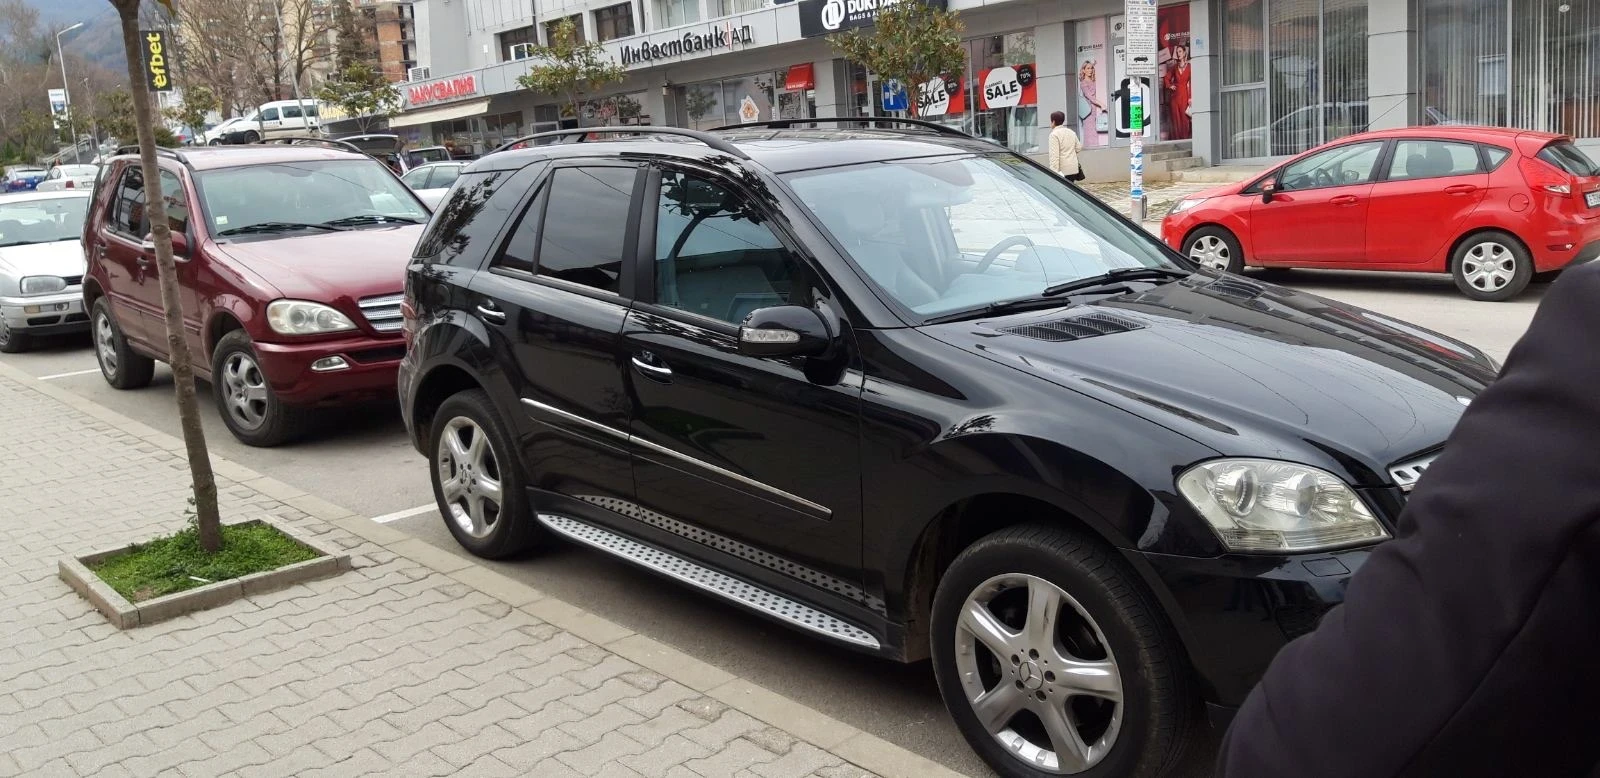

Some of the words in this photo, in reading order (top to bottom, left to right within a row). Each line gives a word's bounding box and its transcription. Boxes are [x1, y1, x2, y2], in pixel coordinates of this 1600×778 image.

[849, 12, 866, 21] BAGS
[146, 32, 167, 88] efbet
[620, 25, 726, 65] Инвестбанк
[986, 80, 1018, 101] SALE
